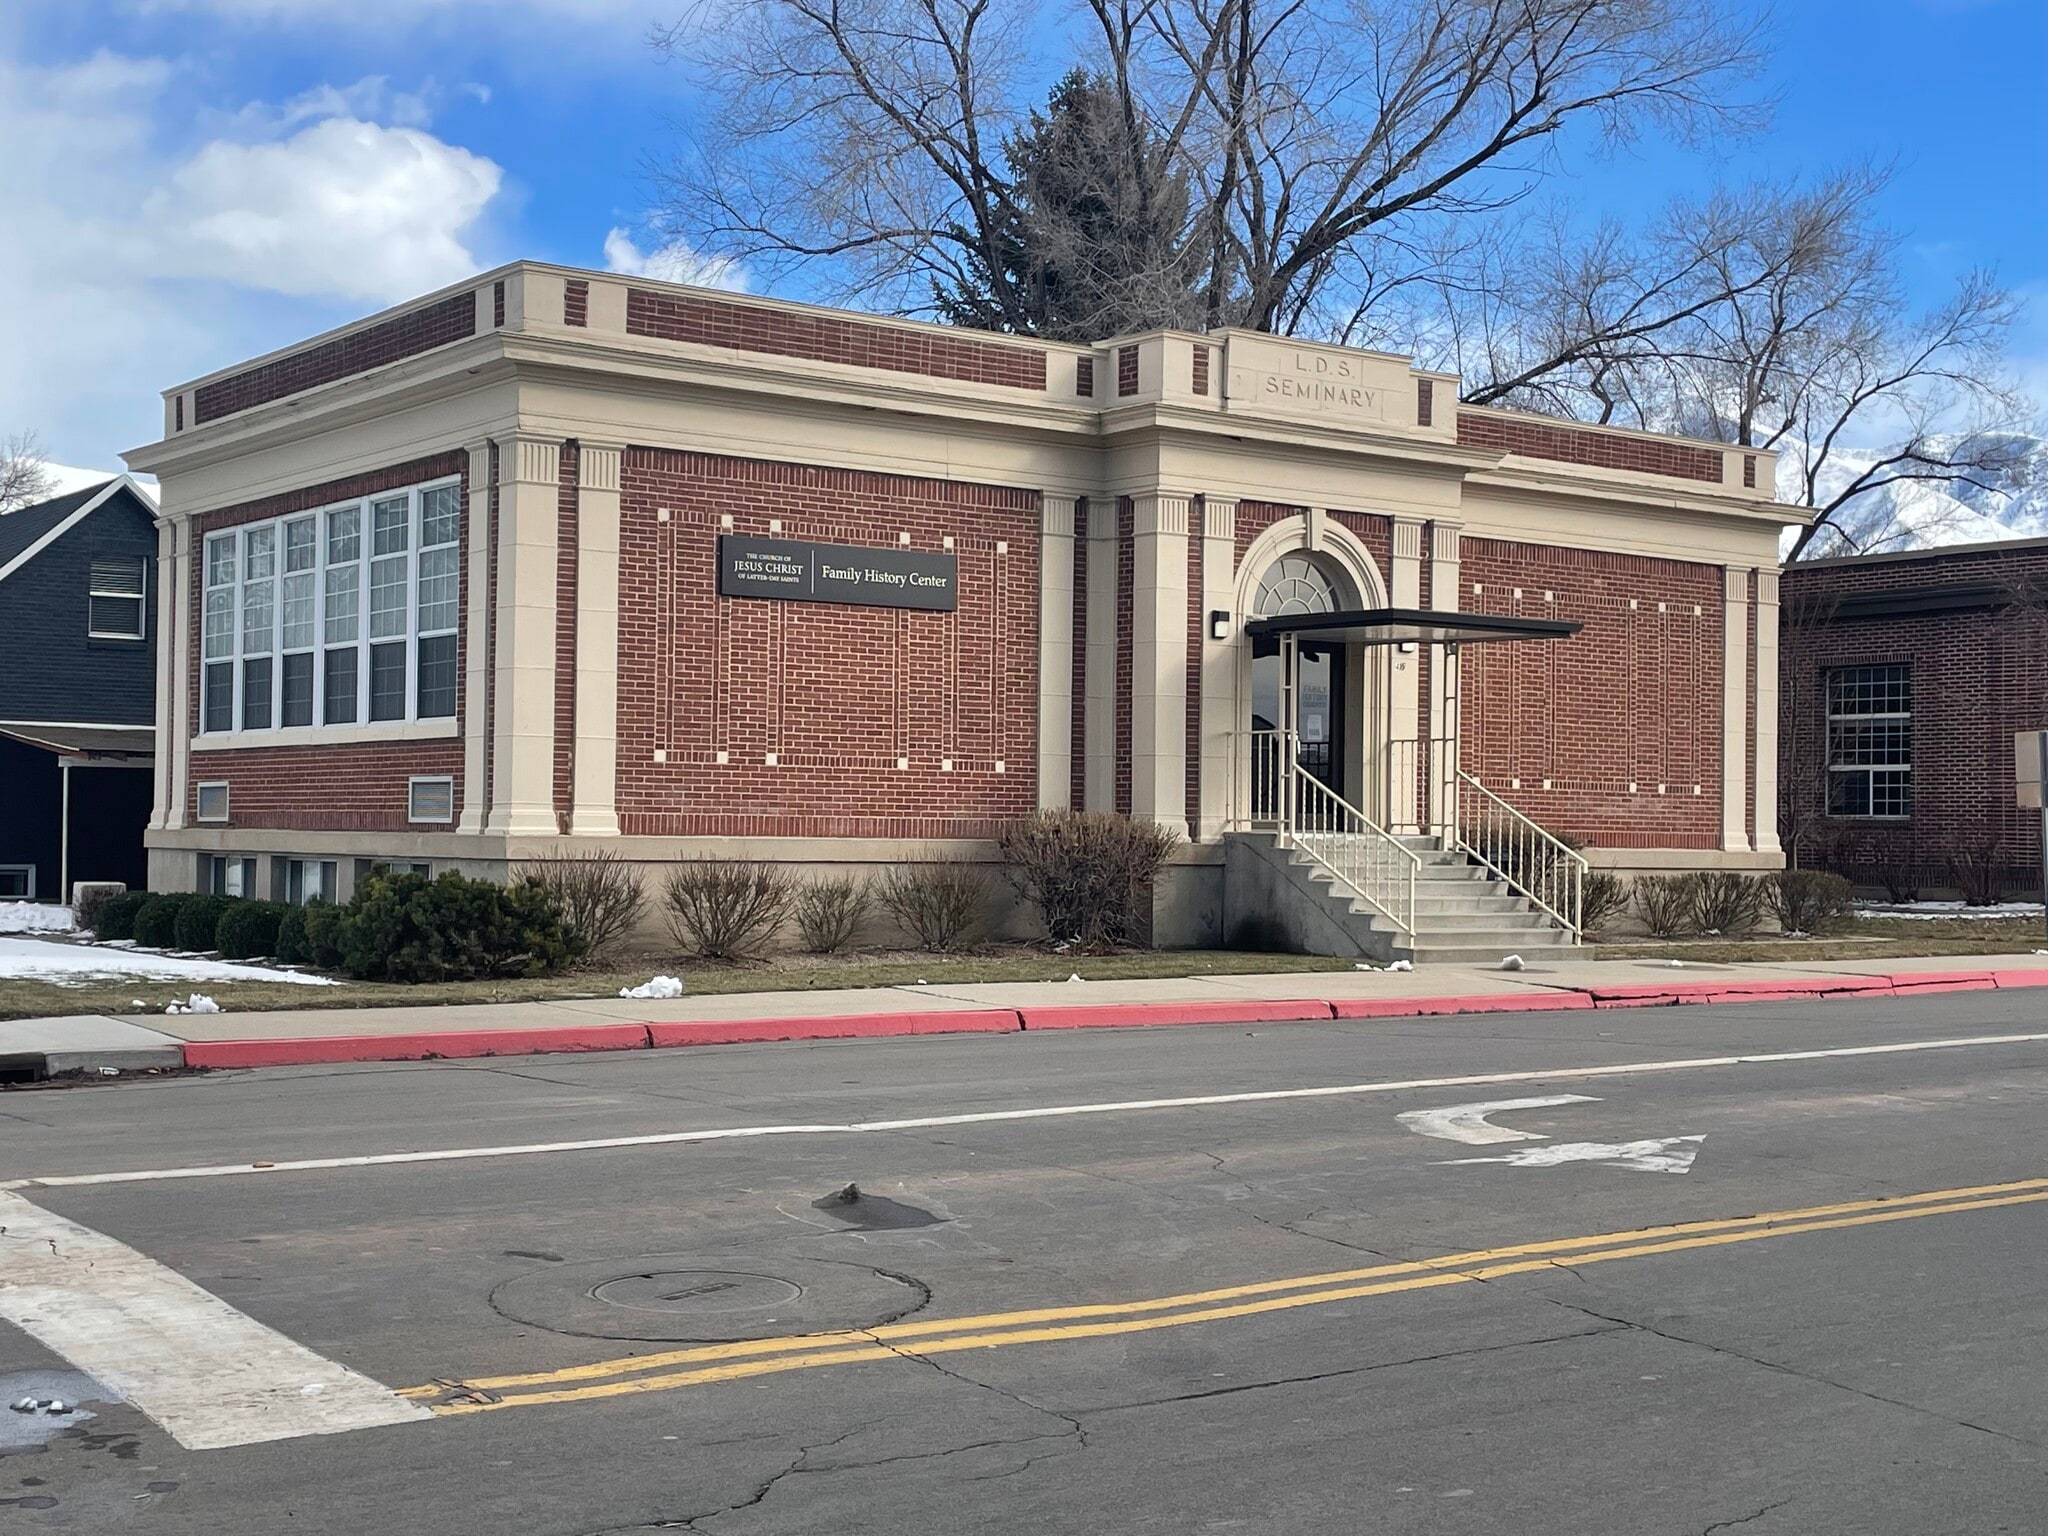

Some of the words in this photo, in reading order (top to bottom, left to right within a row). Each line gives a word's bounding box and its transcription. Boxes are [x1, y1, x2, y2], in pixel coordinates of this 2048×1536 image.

[1265, 376, 1376, 408] SEMINARY
[759, 553, 783, 562] CHURCH
[734, 560, 763, 572] JESUS
[765, 562, 804, 575] CHRIST
[821, 565, 862, 584] Family
[864, 569, 907, 588] History
[909, 572, 947, 588] Center
